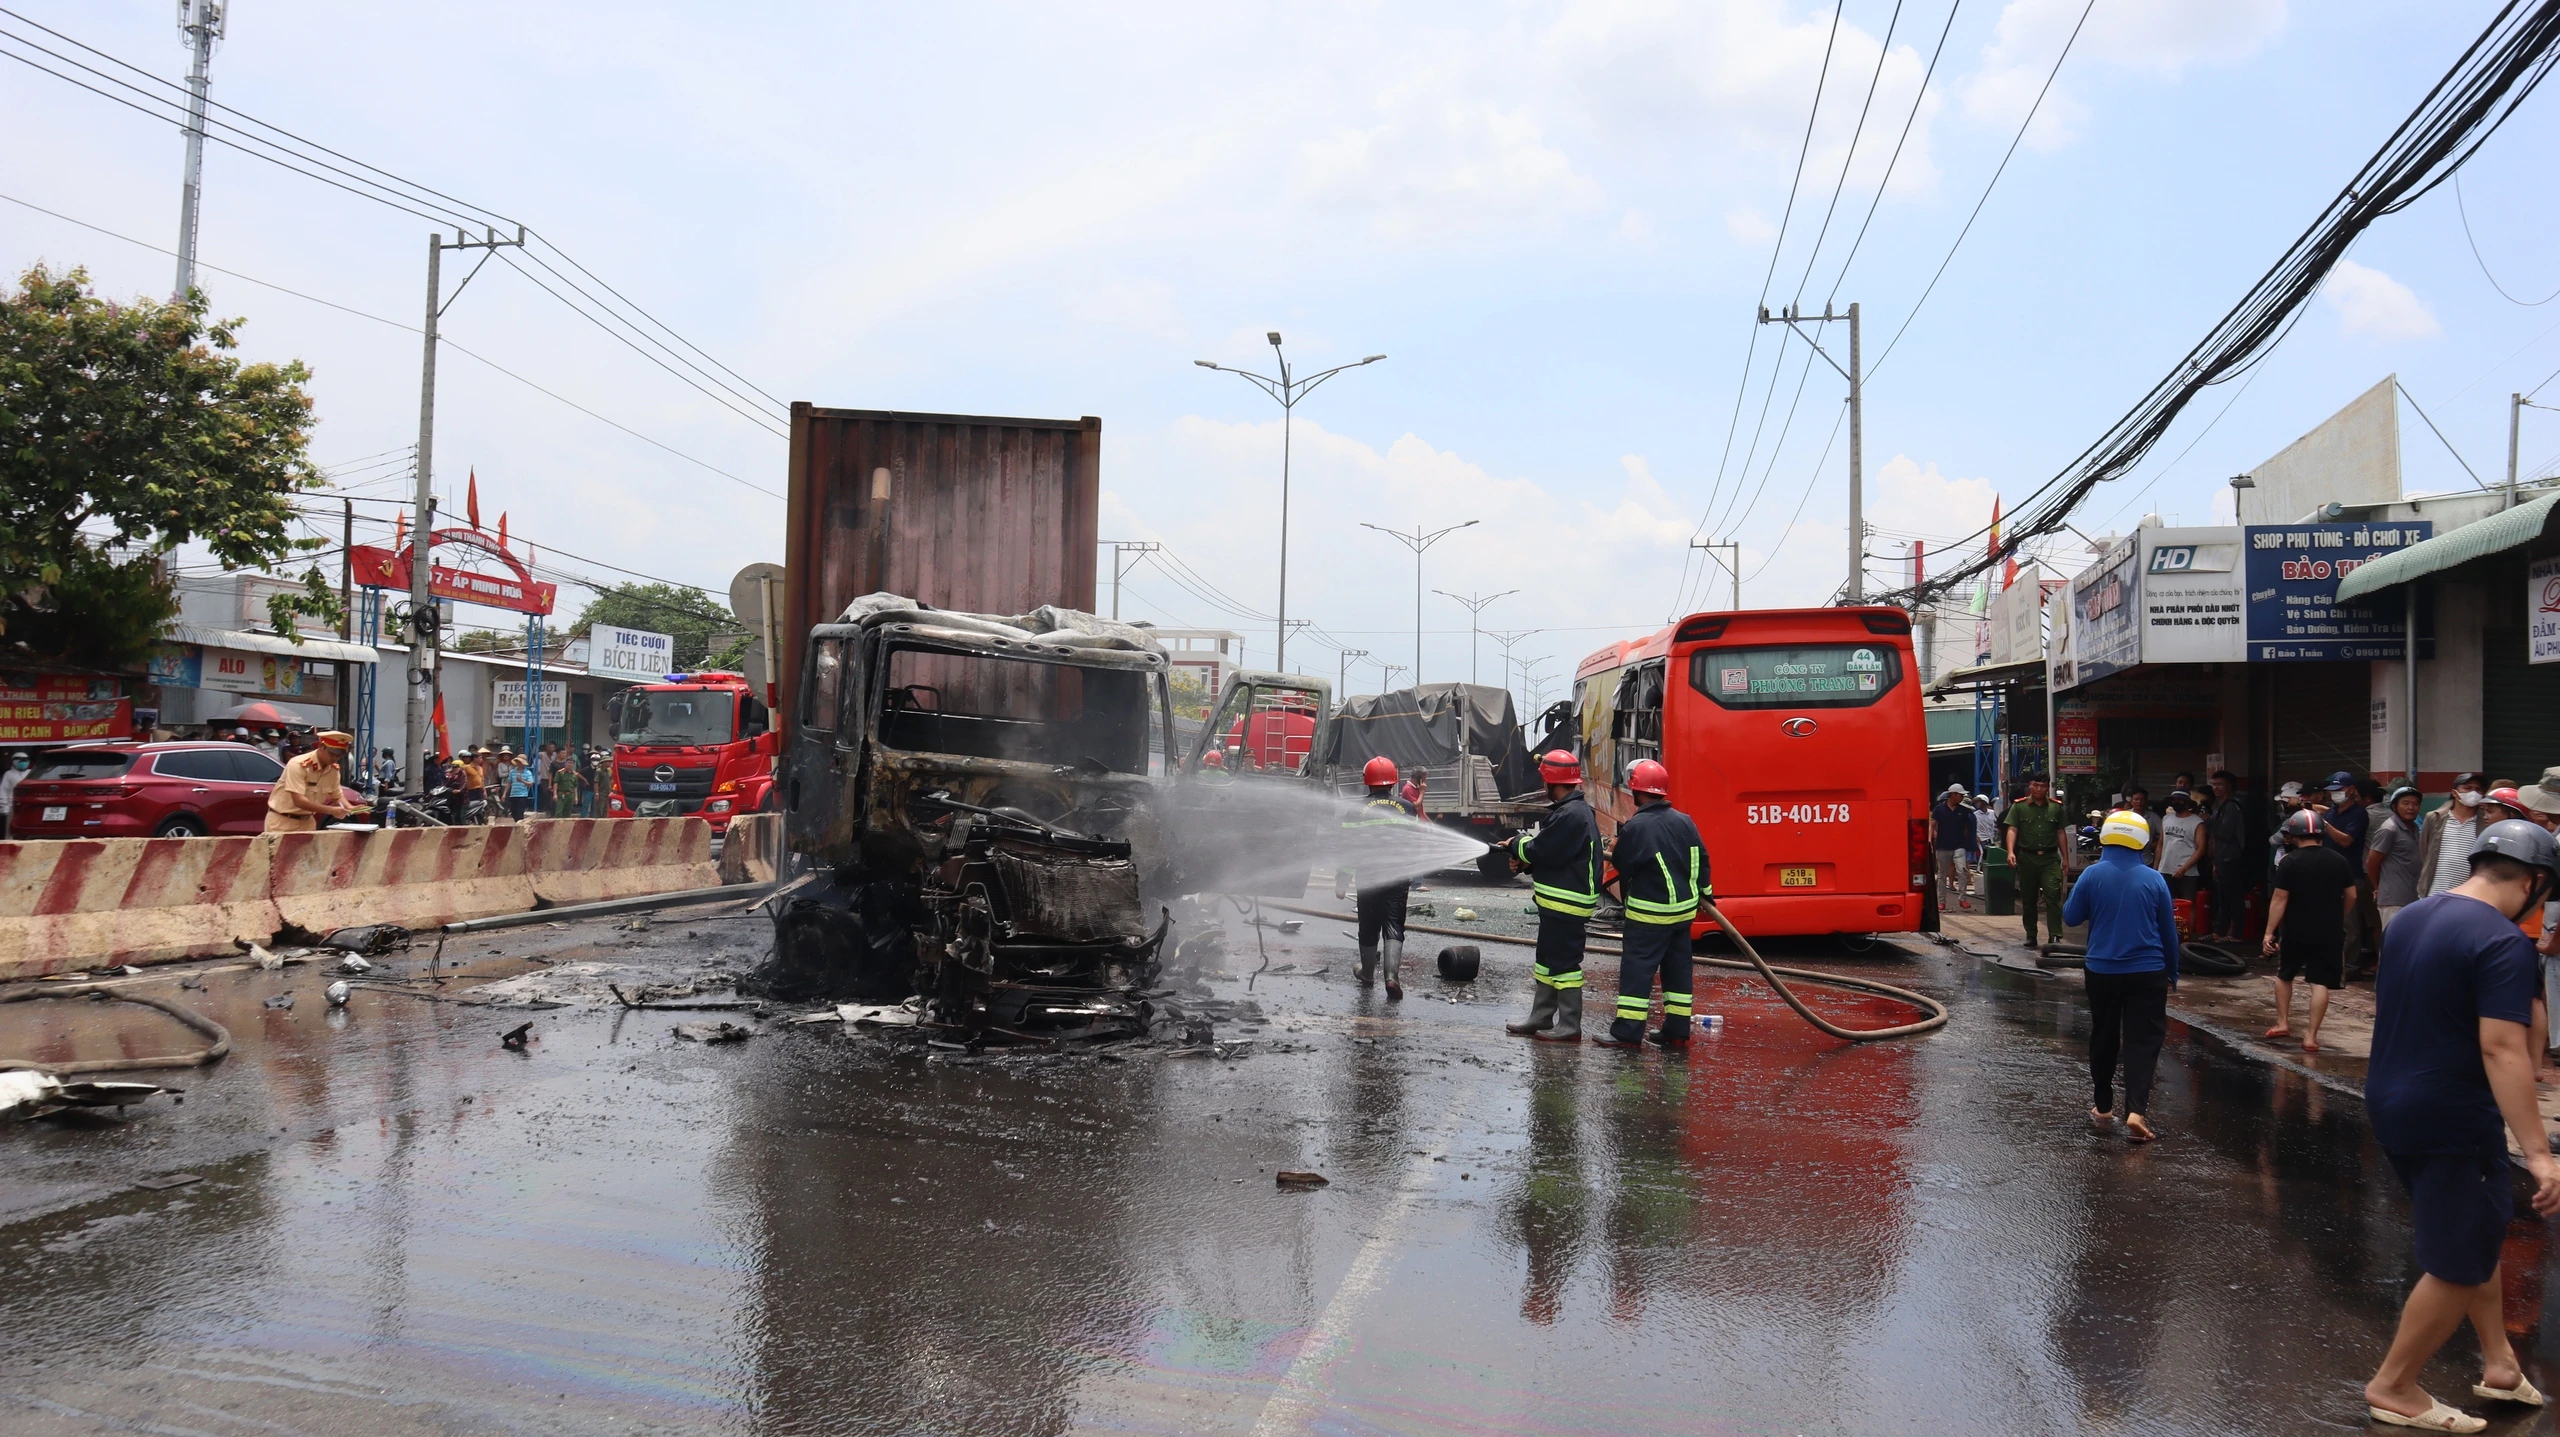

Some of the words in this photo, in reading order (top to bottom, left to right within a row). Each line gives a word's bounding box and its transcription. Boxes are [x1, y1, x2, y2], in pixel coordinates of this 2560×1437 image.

[2254, 533, 2284, 549] SHOP
[2286, 532, 2310, 551] PHỤ
[2313, 529, 2343, 548] TÙNG
[2354, 524, 2370, 547] ĐỒ
[2372, 529, 2400, 546] CHƠI
[2404, 530, 2420, 546] XE
[2282, 555, 2332, 580] BẢO
[434, 572, 444, 584] 7
[452, 570, 469, 589] ẤP
[471, 580, 500, 596] MINH
[502, 584, 522, 599] HÒA
[2251, 588, 2276, 602] Chuyên
[2286, 595, 2311, 606] Nâng
[2313, 594, 2332, 606] Cấp
[2150, 604, 2164, 614] NHÀ
[2166, 604, 2185, 614] PHÂN
[2187, 603, 2204, 613] PHỐI
[2205, 602, 2220, 612] DẦU
[2222, 602, 2240, 612] NHỚT
[2286, 609, 2300, 621] Vệ
[2304, 608, 2327, 618] Sinh
[2151, 616, 2172, 626] CHÍNH
[2202, 616, 2216, 626] ĐỘC
[2217, 614, 2240, 626] QUYỀN
[2372, 624, 2389, 633] Tra
[2533, 617, 2556, 638] ĐẦM
[616, 630, 638, 647] TIỆC
[641, 634, 666, 650] CƯỚI
[1857, 651, 1870, 661] 44
[2534, 641, 2546, 657] ÂU
[218, 658, 245, 674] ALO
[602, 644, 637, 670] BÍCH
[640, 650, 670, 674] LIÊN
[1774, 663, 1808, 675] CÔNG
[1810, 664, 1827, 674] TY
[502, 682, 527, 693] TIỆC
[1751, 677, 1808, 694] PHƯƠNG
[1809, 676, 1855, 692] TRANG
[15, 705, 40, 719] RIÊU
[22, 726, 52, 738] CANH
[2059, 746, 2094, 754] 99.000
[1748, 804, 1850, 824] 51B-401.78
[1784, 877, 1813, 885] 401.78
